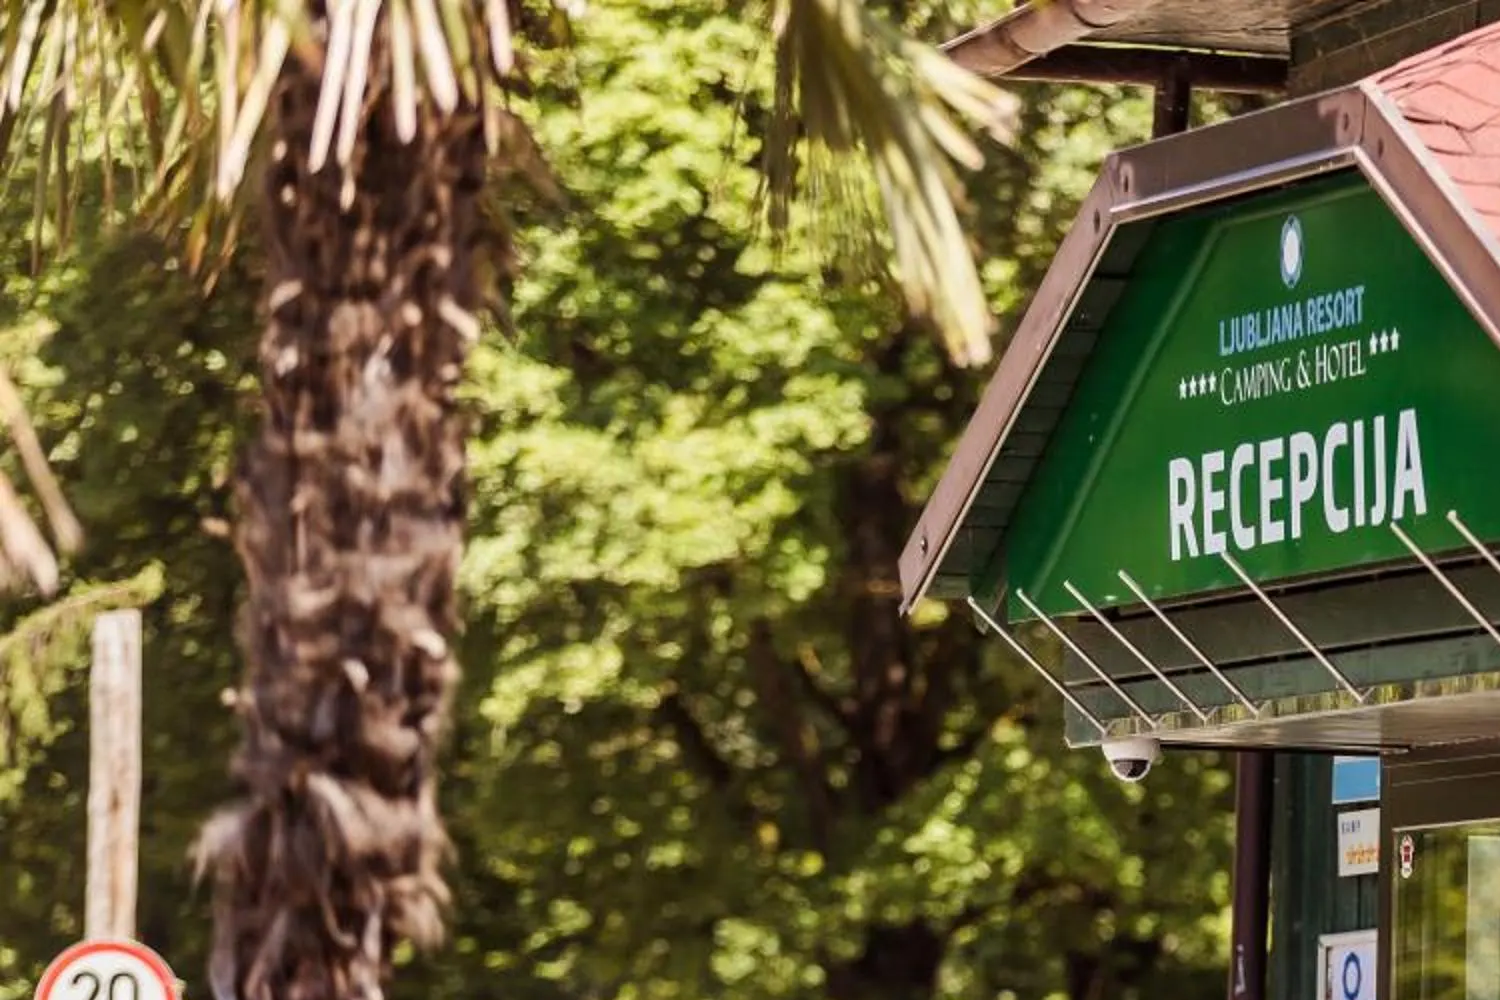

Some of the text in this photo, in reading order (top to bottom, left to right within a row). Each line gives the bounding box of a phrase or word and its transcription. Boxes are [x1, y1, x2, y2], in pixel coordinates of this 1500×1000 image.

[1218, 285, 1365, 356] LJUBLJANA RESORT
[1219, 340, 1367, 406] CAMPING & HOTEL
[1168, 407, 1427, 562] RECEPCIJA
